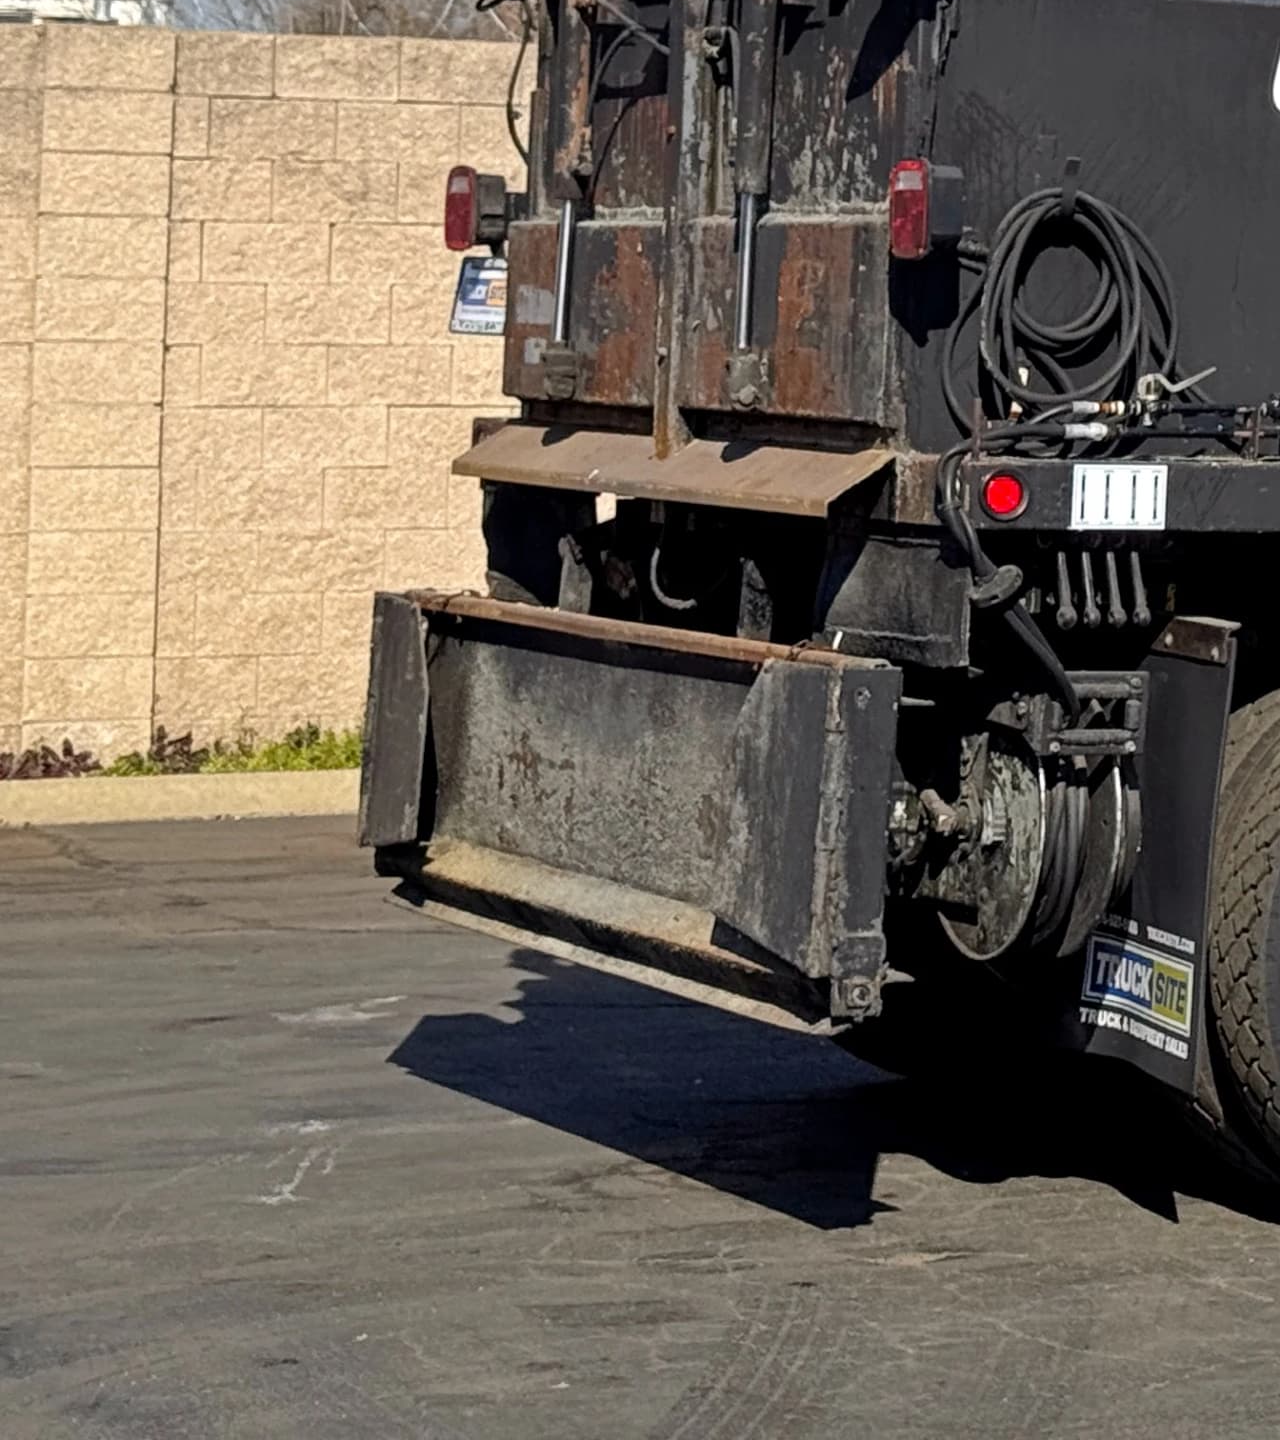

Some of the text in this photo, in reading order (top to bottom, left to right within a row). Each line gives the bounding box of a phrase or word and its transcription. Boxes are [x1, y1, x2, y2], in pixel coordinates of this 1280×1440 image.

[1096, 951, 1188, 1014] TRUCK SITE
[1079, 1006, 1122, 1030] TRUCK
